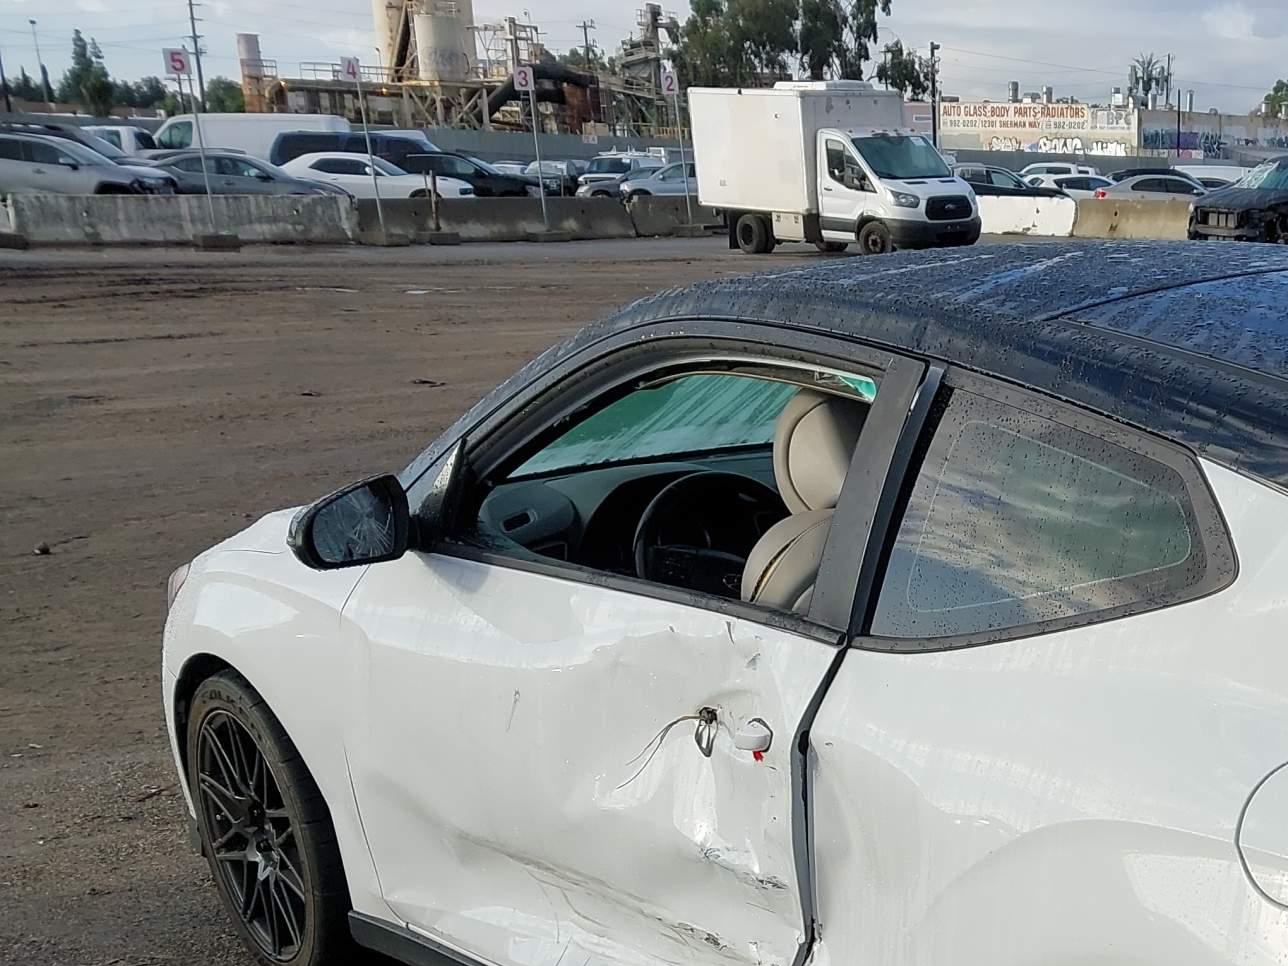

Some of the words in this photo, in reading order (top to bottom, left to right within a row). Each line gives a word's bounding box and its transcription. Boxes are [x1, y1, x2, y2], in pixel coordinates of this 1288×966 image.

[170, 52, 186, 72] 5
[347, 60, 357, 79] 4
[518, 70, 529, 88] 3
[664, 75, 675, 92] 2
[942, 105, 962, 117] AUTO
[999, 120, 1026, 129] SHERMAN
